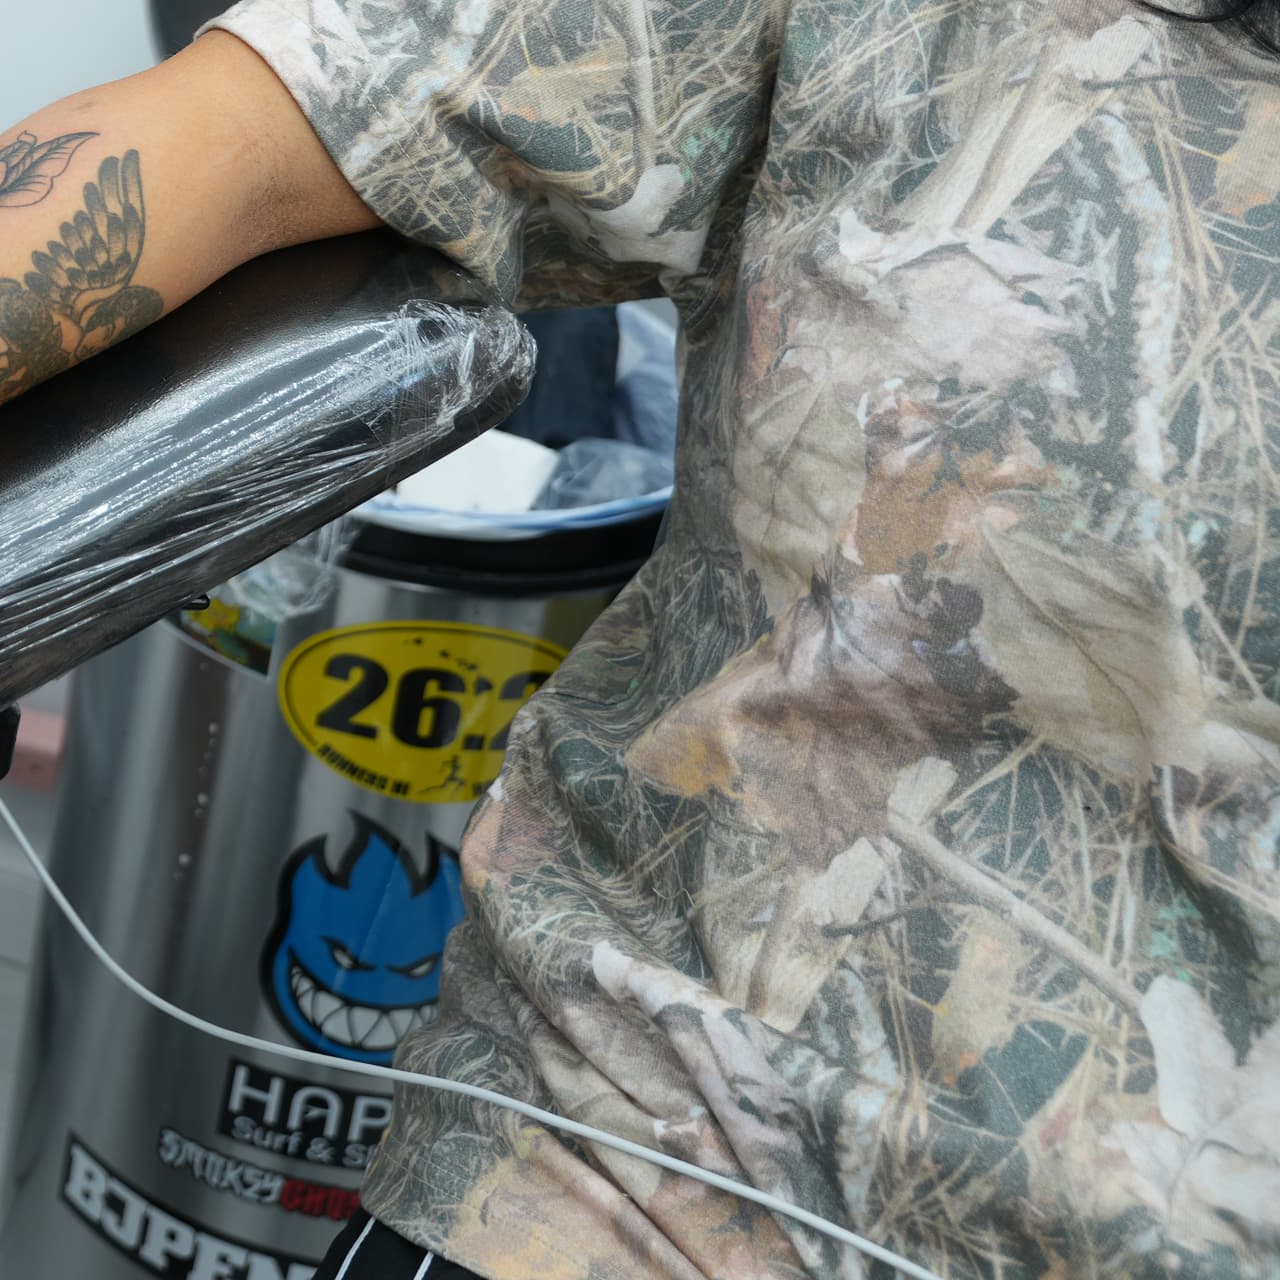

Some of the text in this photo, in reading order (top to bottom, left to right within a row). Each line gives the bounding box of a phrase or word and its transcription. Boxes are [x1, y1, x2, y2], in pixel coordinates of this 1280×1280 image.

[316, 742, 389, 791] RUNNERS
[228, 1063, 392, 1142] HAP
[232, 1116, 302, 1155] Surf
[305, 1136, 336, 1164] &
